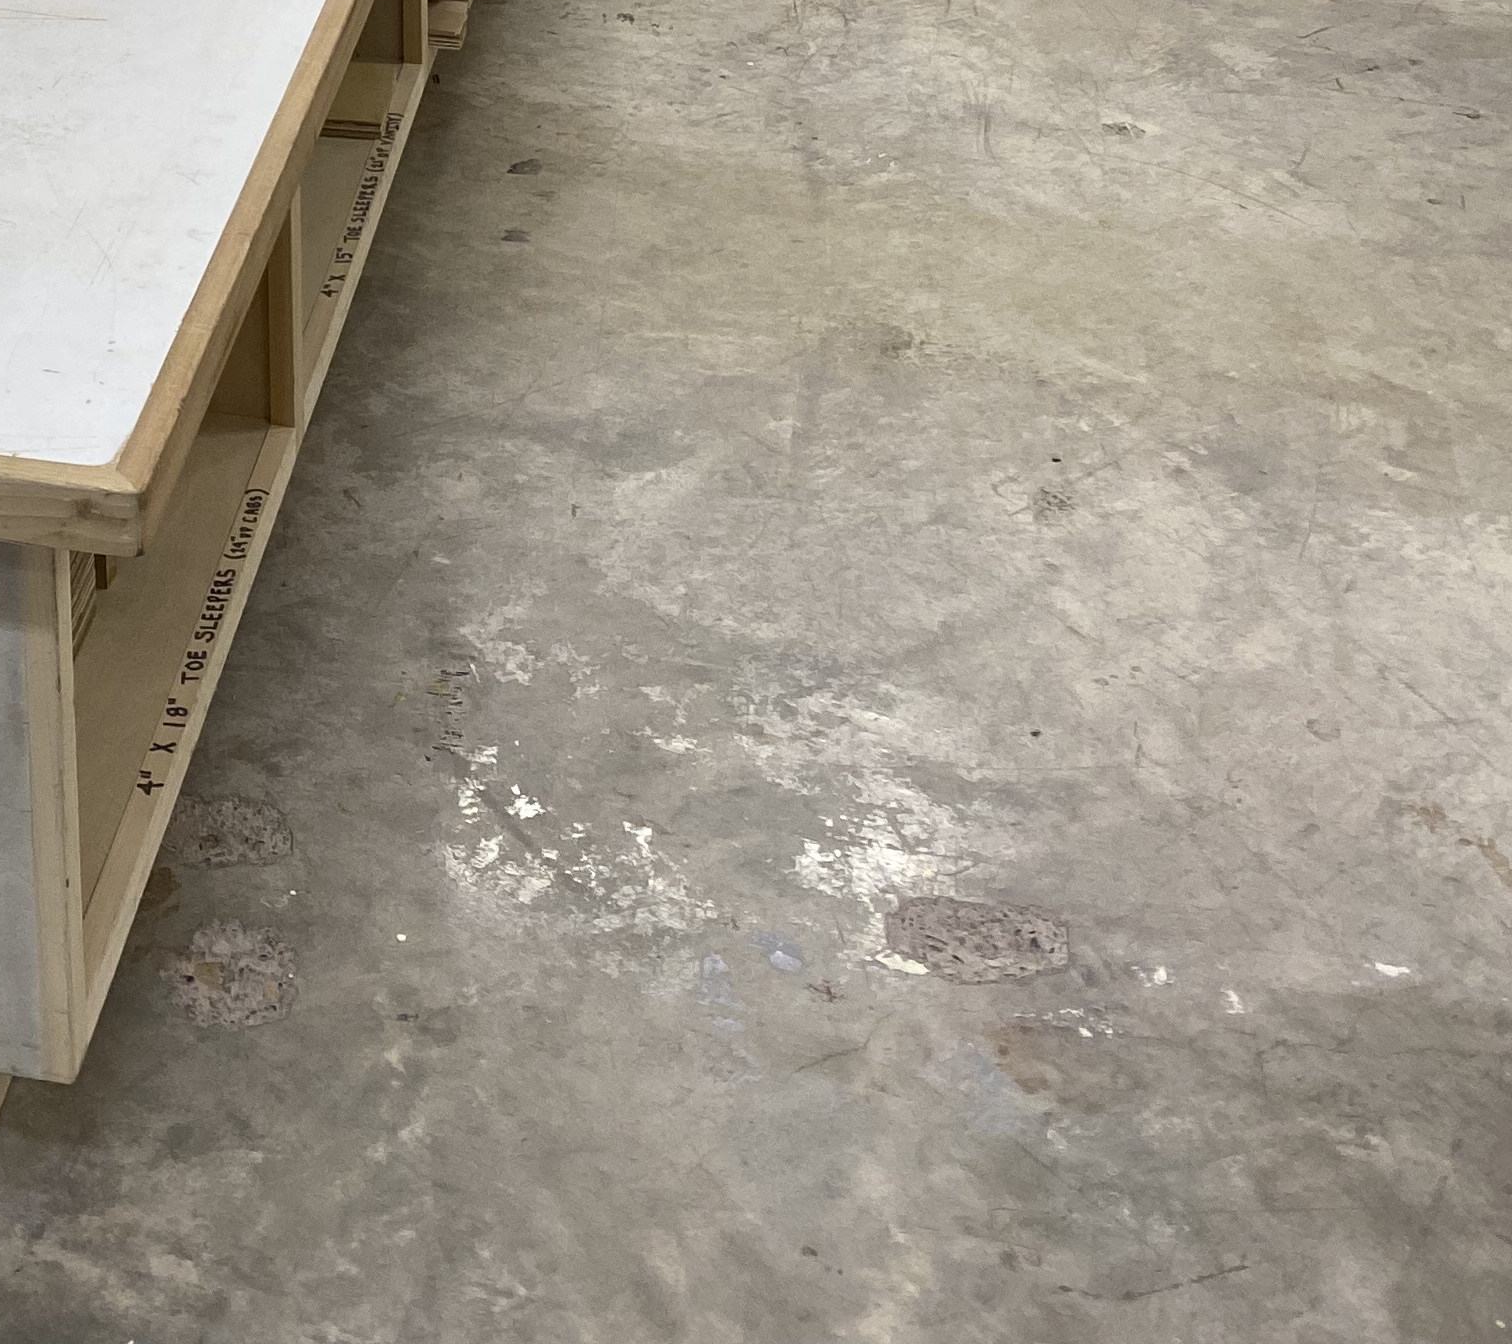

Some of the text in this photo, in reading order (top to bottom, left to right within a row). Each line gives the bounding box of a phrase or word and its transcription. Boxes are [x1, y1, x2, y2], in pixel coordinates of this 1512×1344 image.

[350, 176, 378, 222] SLEEPERS
[343, 225, 363, 244] TOE
[334, 247, 353, 263] 15"
[320, 283, 339, 298] 4"
[242, 488, 270, 523] CABS)
[194, 568, 237, 644] SLEEPERS
[180, 650, 207, 685] TOE
[162, 698, 188, 727] 18"
[149, 742, 177, 753] X
[137, 770, 164, 796] 4"
